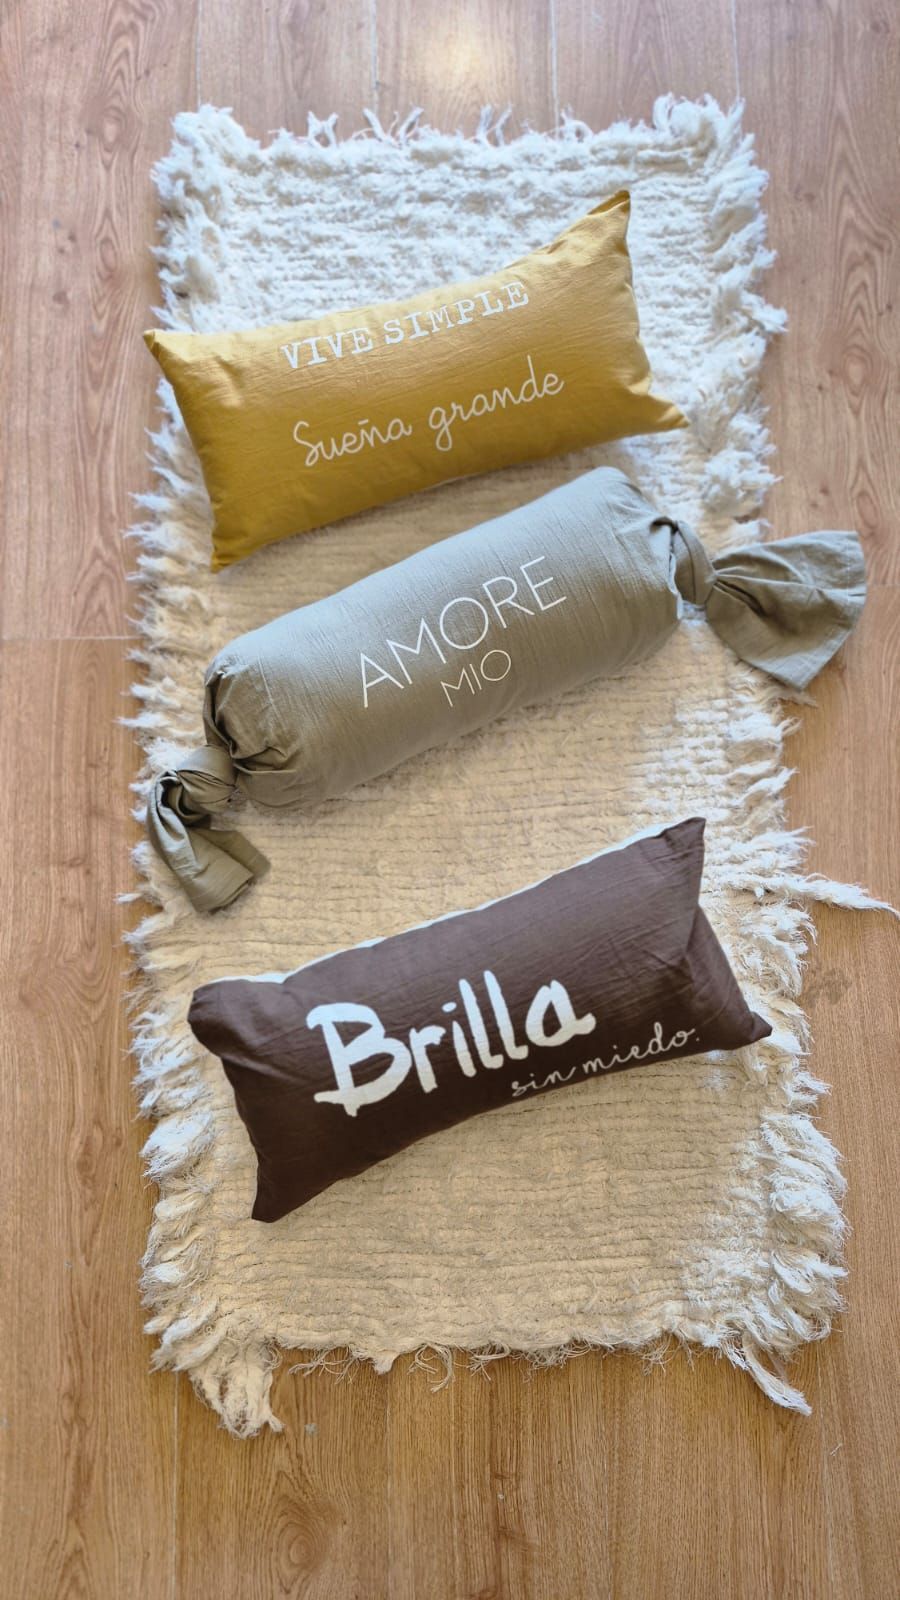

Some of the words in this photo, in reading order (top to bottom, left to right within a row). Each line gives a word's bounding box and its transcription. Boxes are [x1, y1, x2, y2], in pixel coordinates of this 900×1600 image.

[280, 326, 374, 369] VIVE
[383, 281, 530, 345] SIMPLE
[293, 419, 412, 467] Sueña
[428, 354, 565, 452] grande
[360, 555, 567, 709] AMORE
[440, 649, 512, 708] MIO
[305, 969, 597, 1118] Brilla
[511, 1062, 577, 1097] sin
